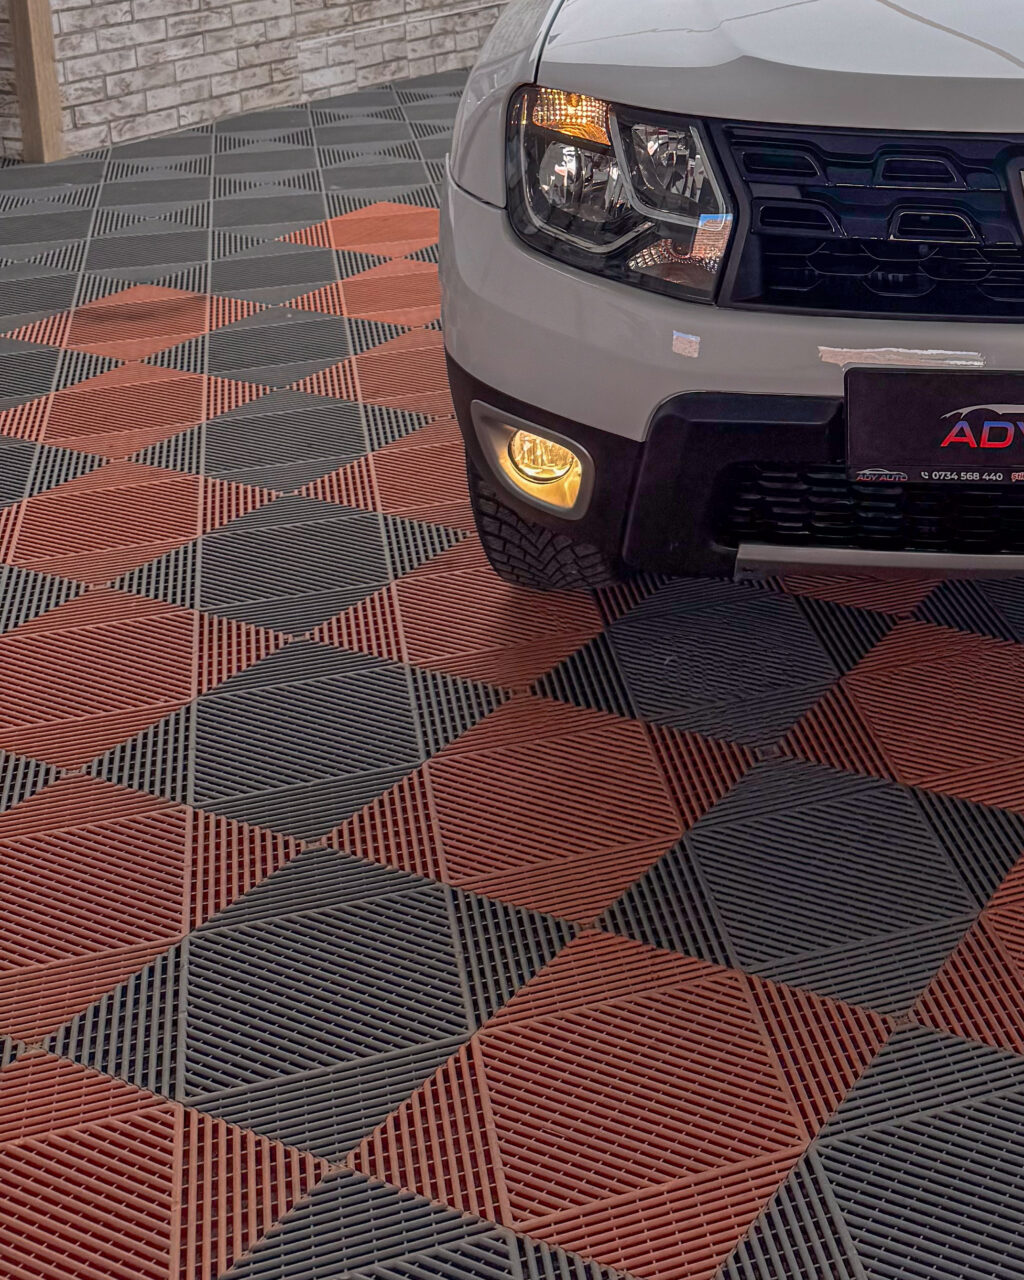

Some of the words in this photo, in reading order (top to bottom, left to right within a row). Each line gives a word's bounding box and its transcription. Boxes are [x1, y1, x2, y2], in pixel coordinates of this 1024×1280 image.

[932, 471, 958, 480] 0734
[961, 472, 980, 480] 568
[982, 472, 1004, 481] 440
